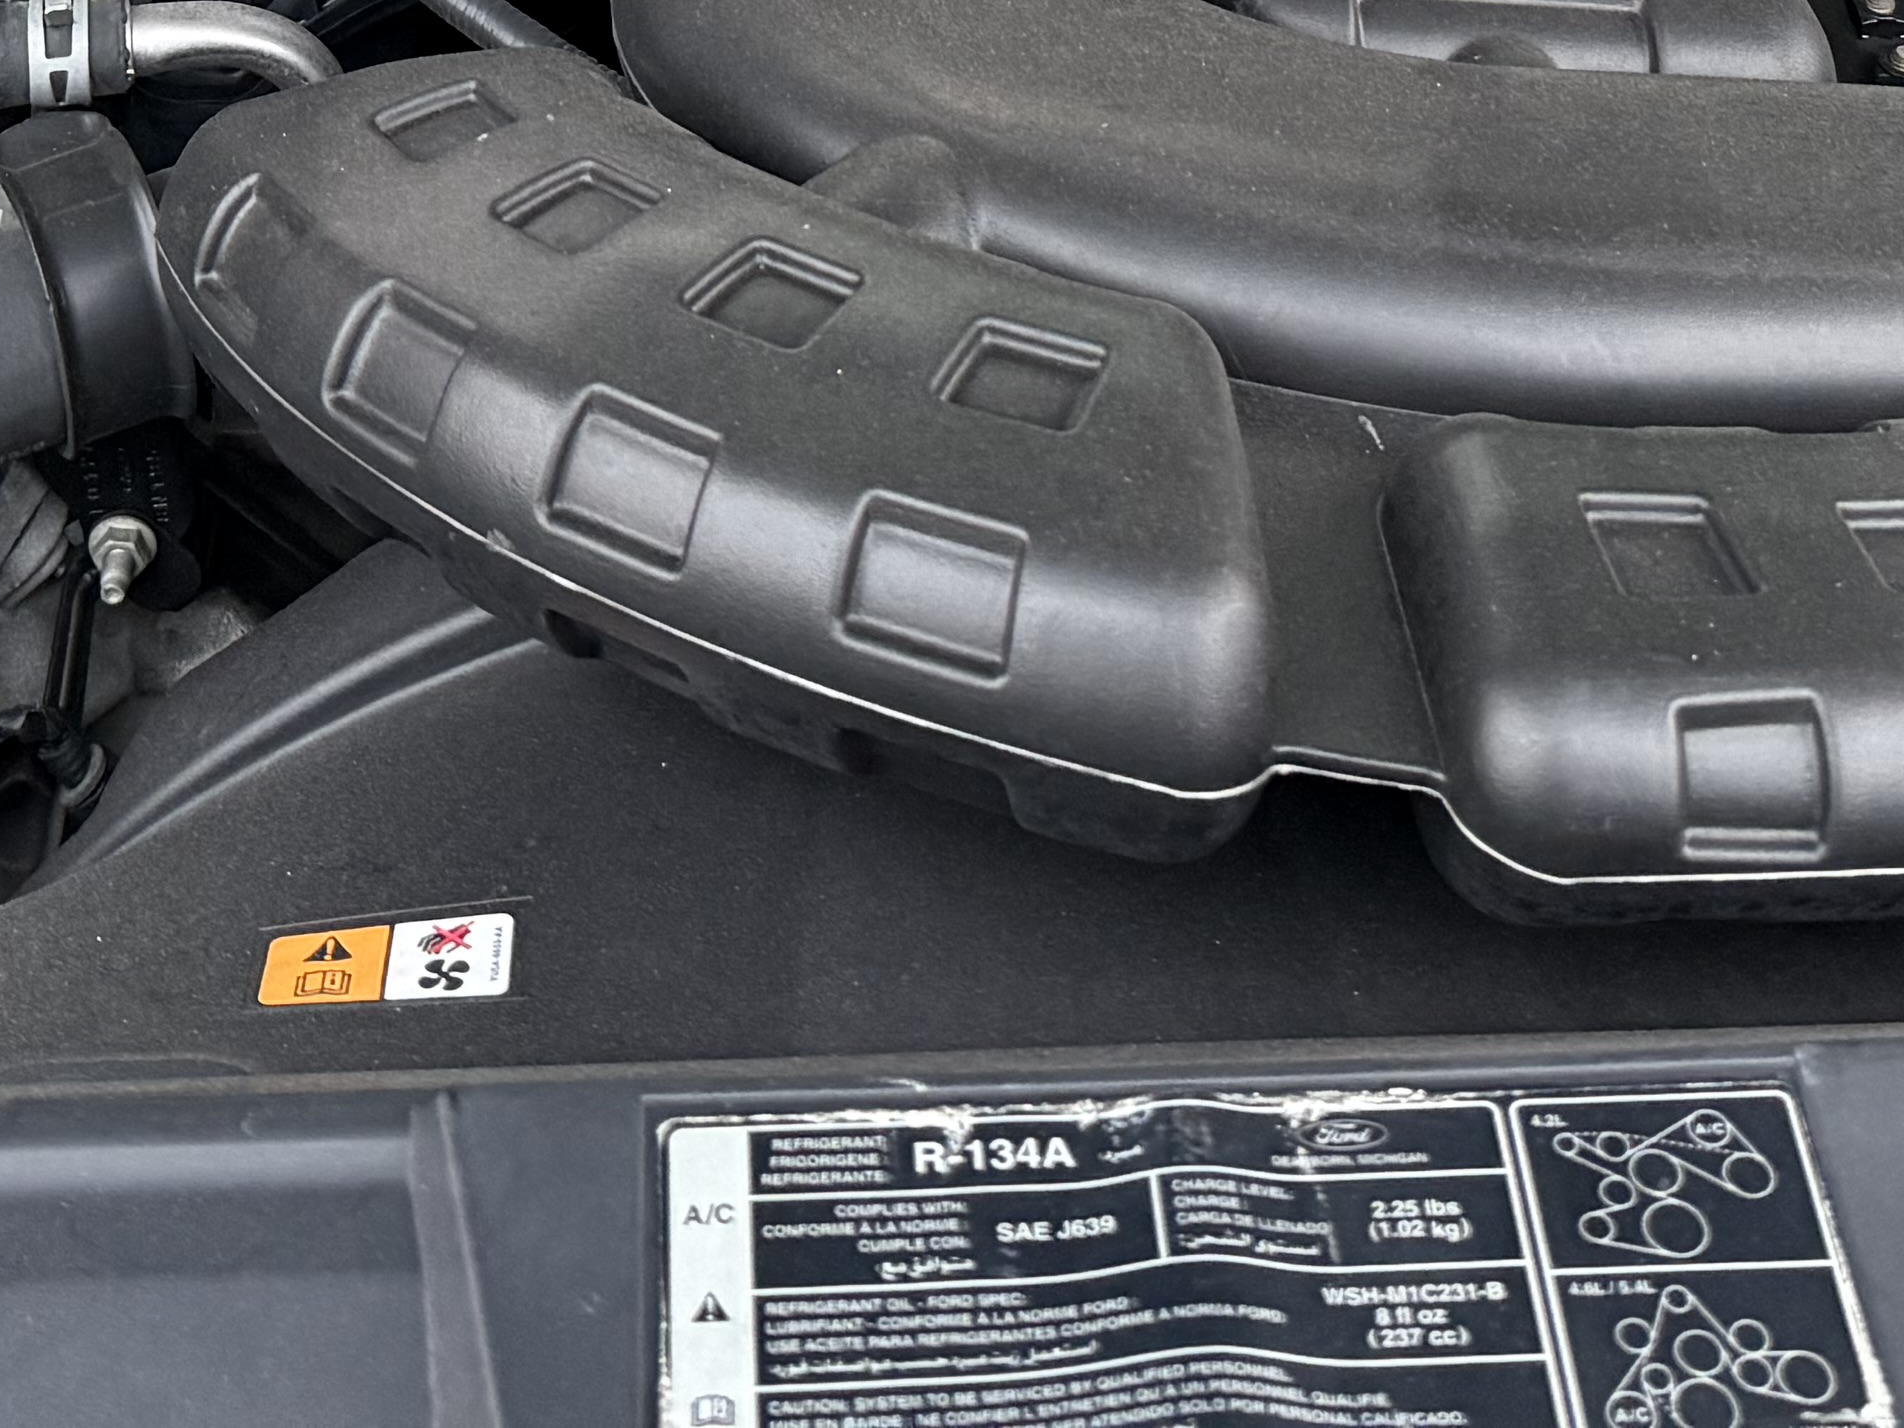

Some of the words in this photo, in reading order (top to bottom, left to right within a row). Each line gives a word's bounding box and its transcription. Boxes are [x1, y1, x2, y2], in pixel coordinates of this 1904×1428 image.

[1314, 1123, 1373, 1145] Ford
[1695, 1122, 1727, 1136] A/C
[912, 1135, 1079, 1175] R-134A
[682, 1203, 738, 1227] A/C
[833, 1202, 919, 1218] COMPLIES
[1371, 1200, 1420, 1220] 2.25
[1424, 1198, 1464, 1219] lbs
[995, 1218, 1053, 1244] SAE
[1057, 1214, 1119, 1241] J639
[1368, 1219, 1424, 1243] (1.02
[1429, 1219, 1474, 1242] kg)
[1320, 1280, 1509, 1307] WSH-M1C231-B
[765, 1297, 882, 1316] REFRIGERANT
[926, 1294, 974, 1310] FORD
[1374, 1307, 1393, 1327] 8
[1417, 1308, 1450, 1324] oz
[1427, 1325, 1472, 1348] cc)
[1096, 1363, 1185, 1390] QUALIFIED
[1614, 1405, 1652, 1424] A/C
